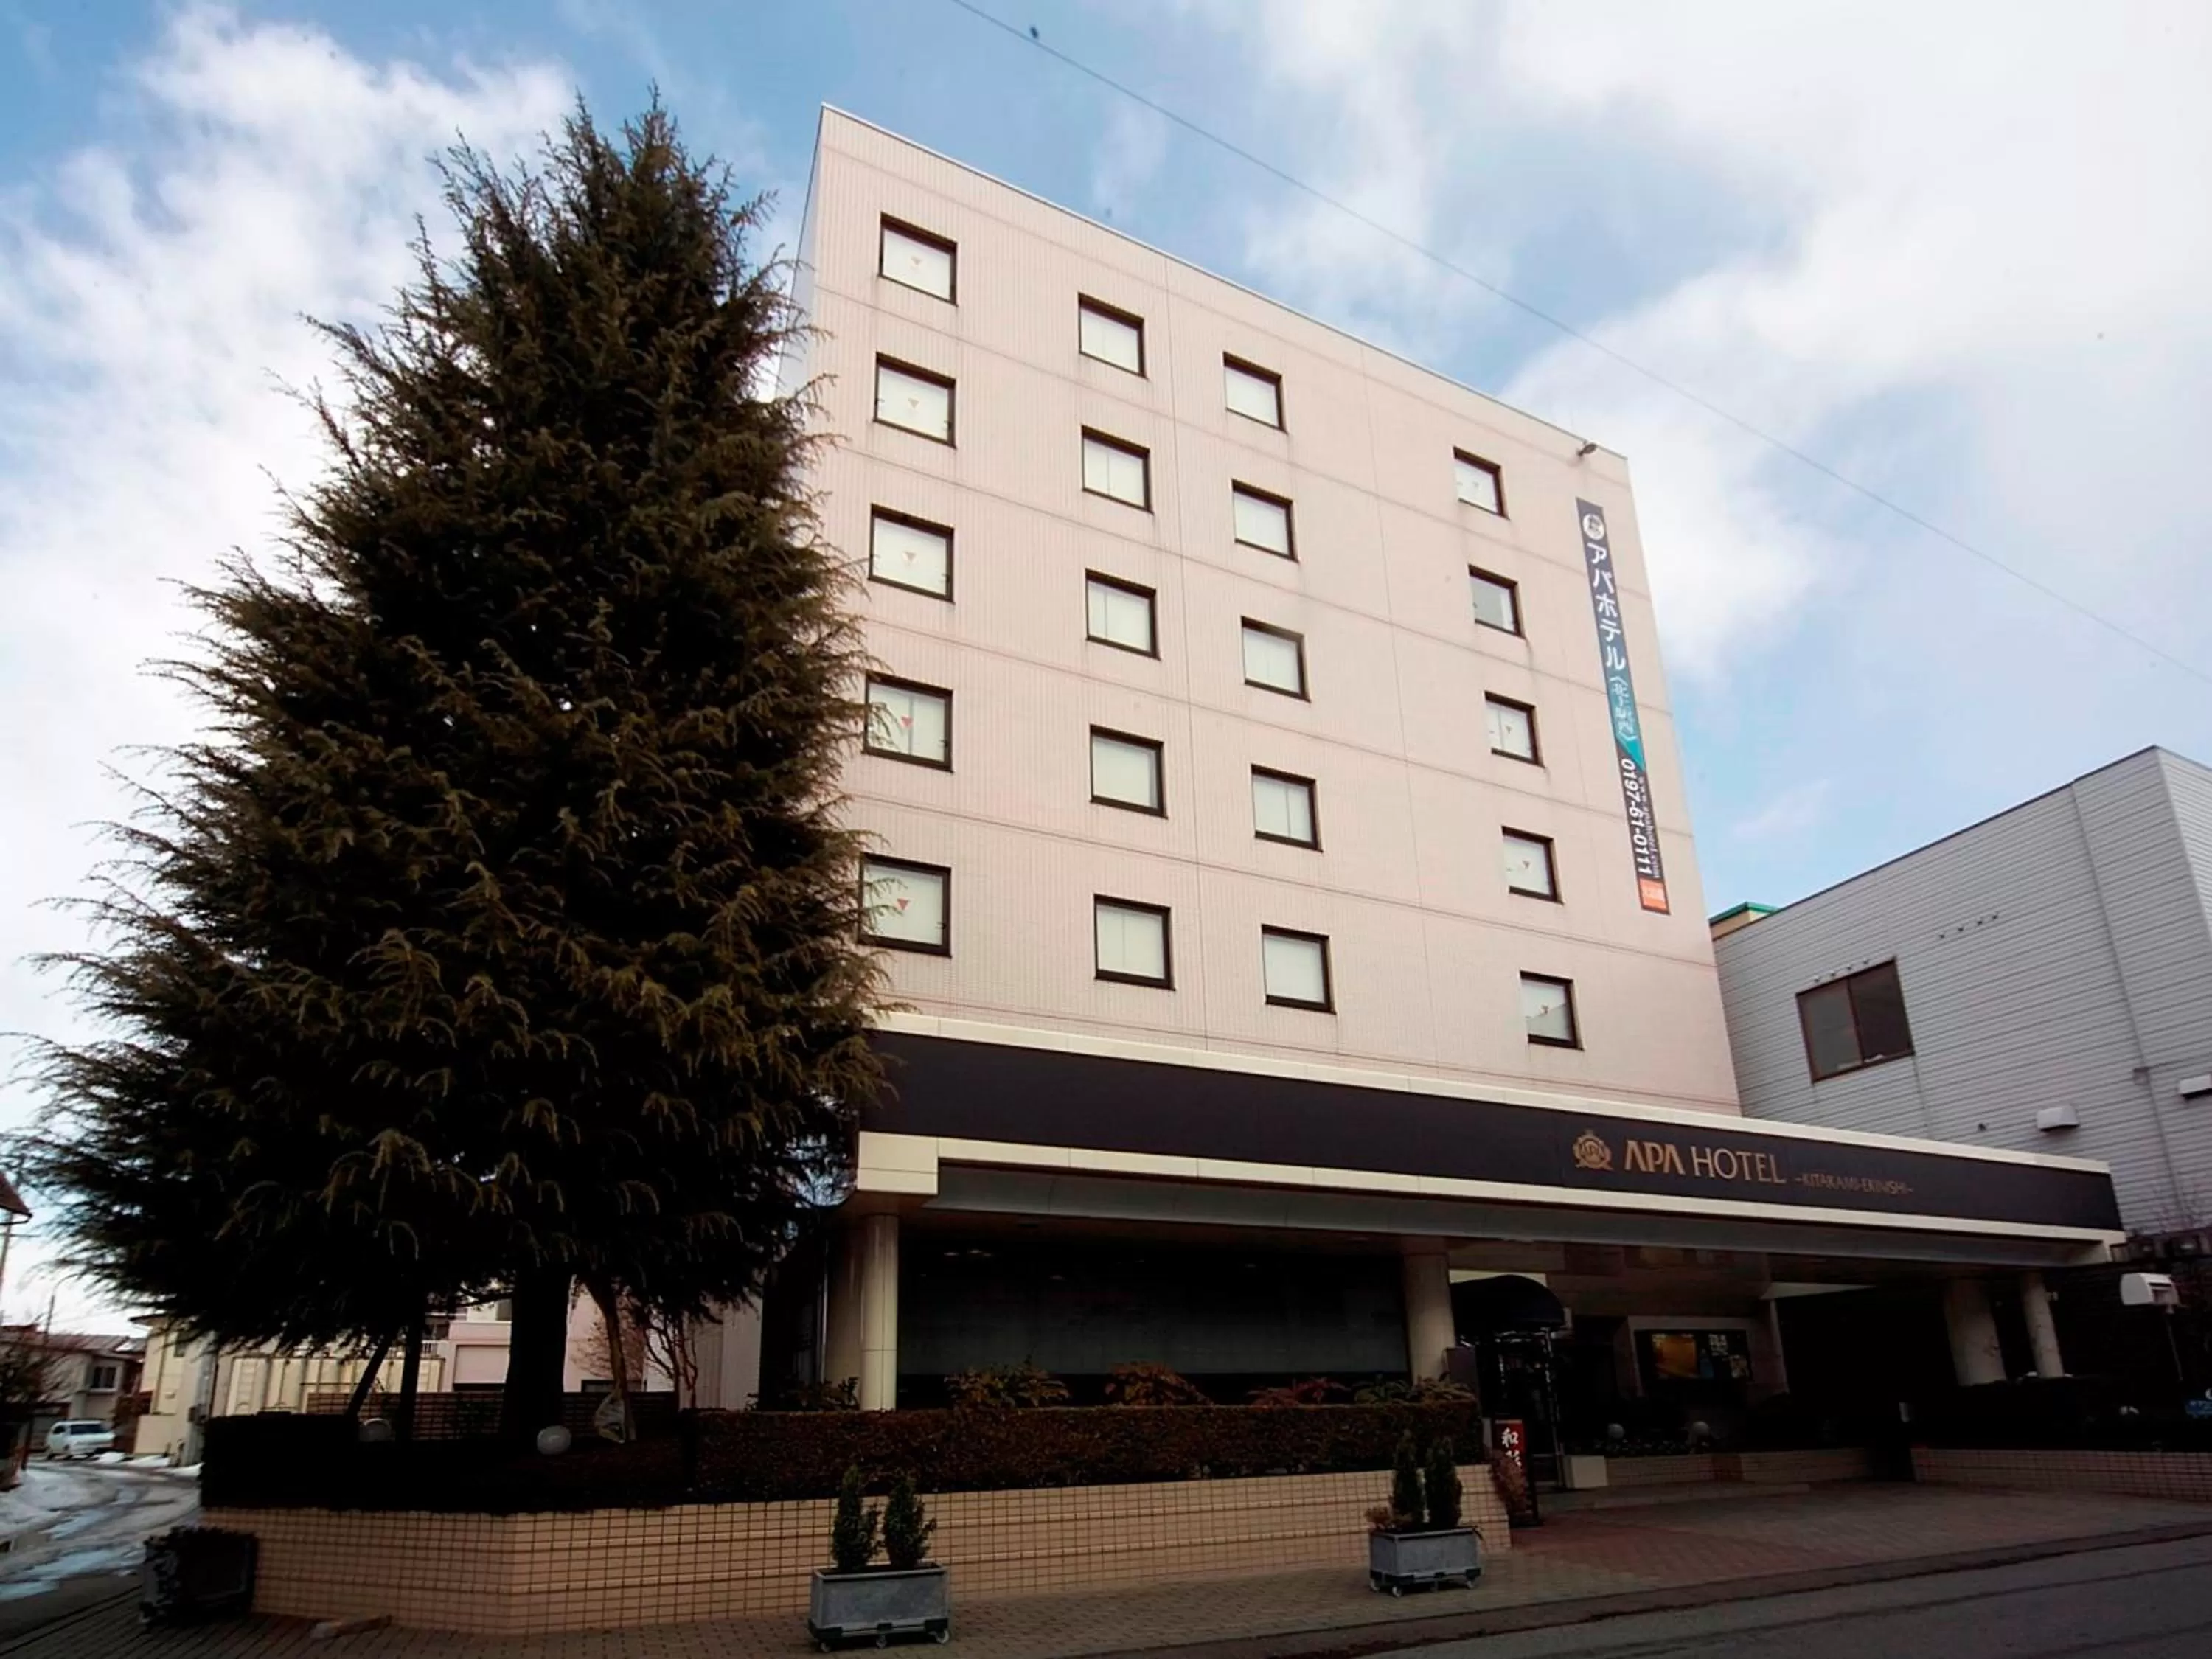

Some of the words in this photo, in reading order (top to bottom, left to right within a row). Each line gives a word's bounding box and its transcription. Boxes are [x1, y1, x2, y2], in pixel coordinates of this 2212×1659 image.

[1587, 542, 1627, 670] アパホテル
[1621, 758, 1652, 874] 0197-61-0111
[1624, 1139, 1686, 1175] APA
[1690, 1145, 1787, 1184] HOTEL
